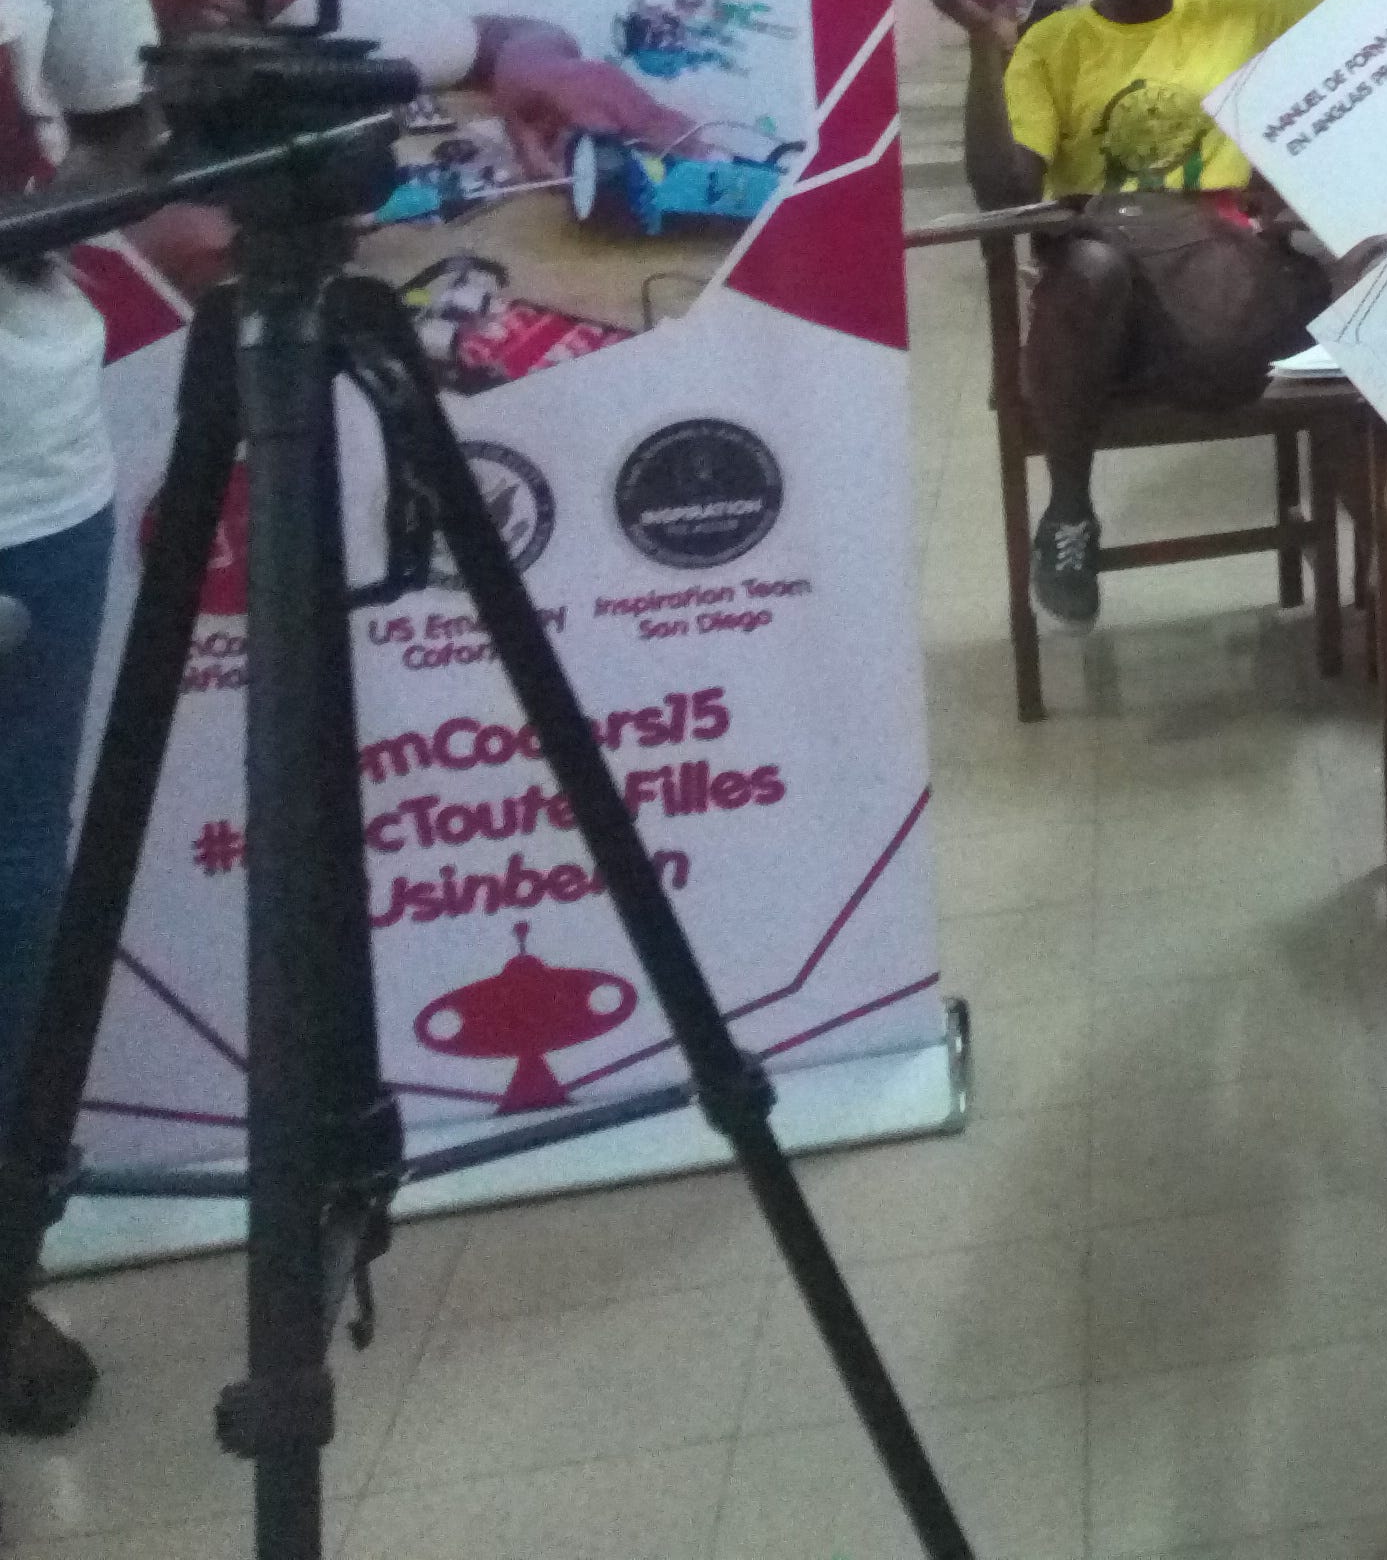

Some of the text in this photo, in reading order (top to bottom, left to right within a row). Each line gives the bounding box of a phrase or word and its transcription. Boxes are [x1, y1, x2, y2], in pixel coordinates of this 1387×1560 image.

[1263, 89, 1326, 142] MANUEL
[1323, 68, 1346, 92] DE
[1285, 133, 1311, 156] EN
[1311, 81, 1372, 135] ANGLAIS
[594, 578, 812, 618] Inspiration Team
[368, 616, 415, 643] US
[639, 609, 773, 640] San Diego
